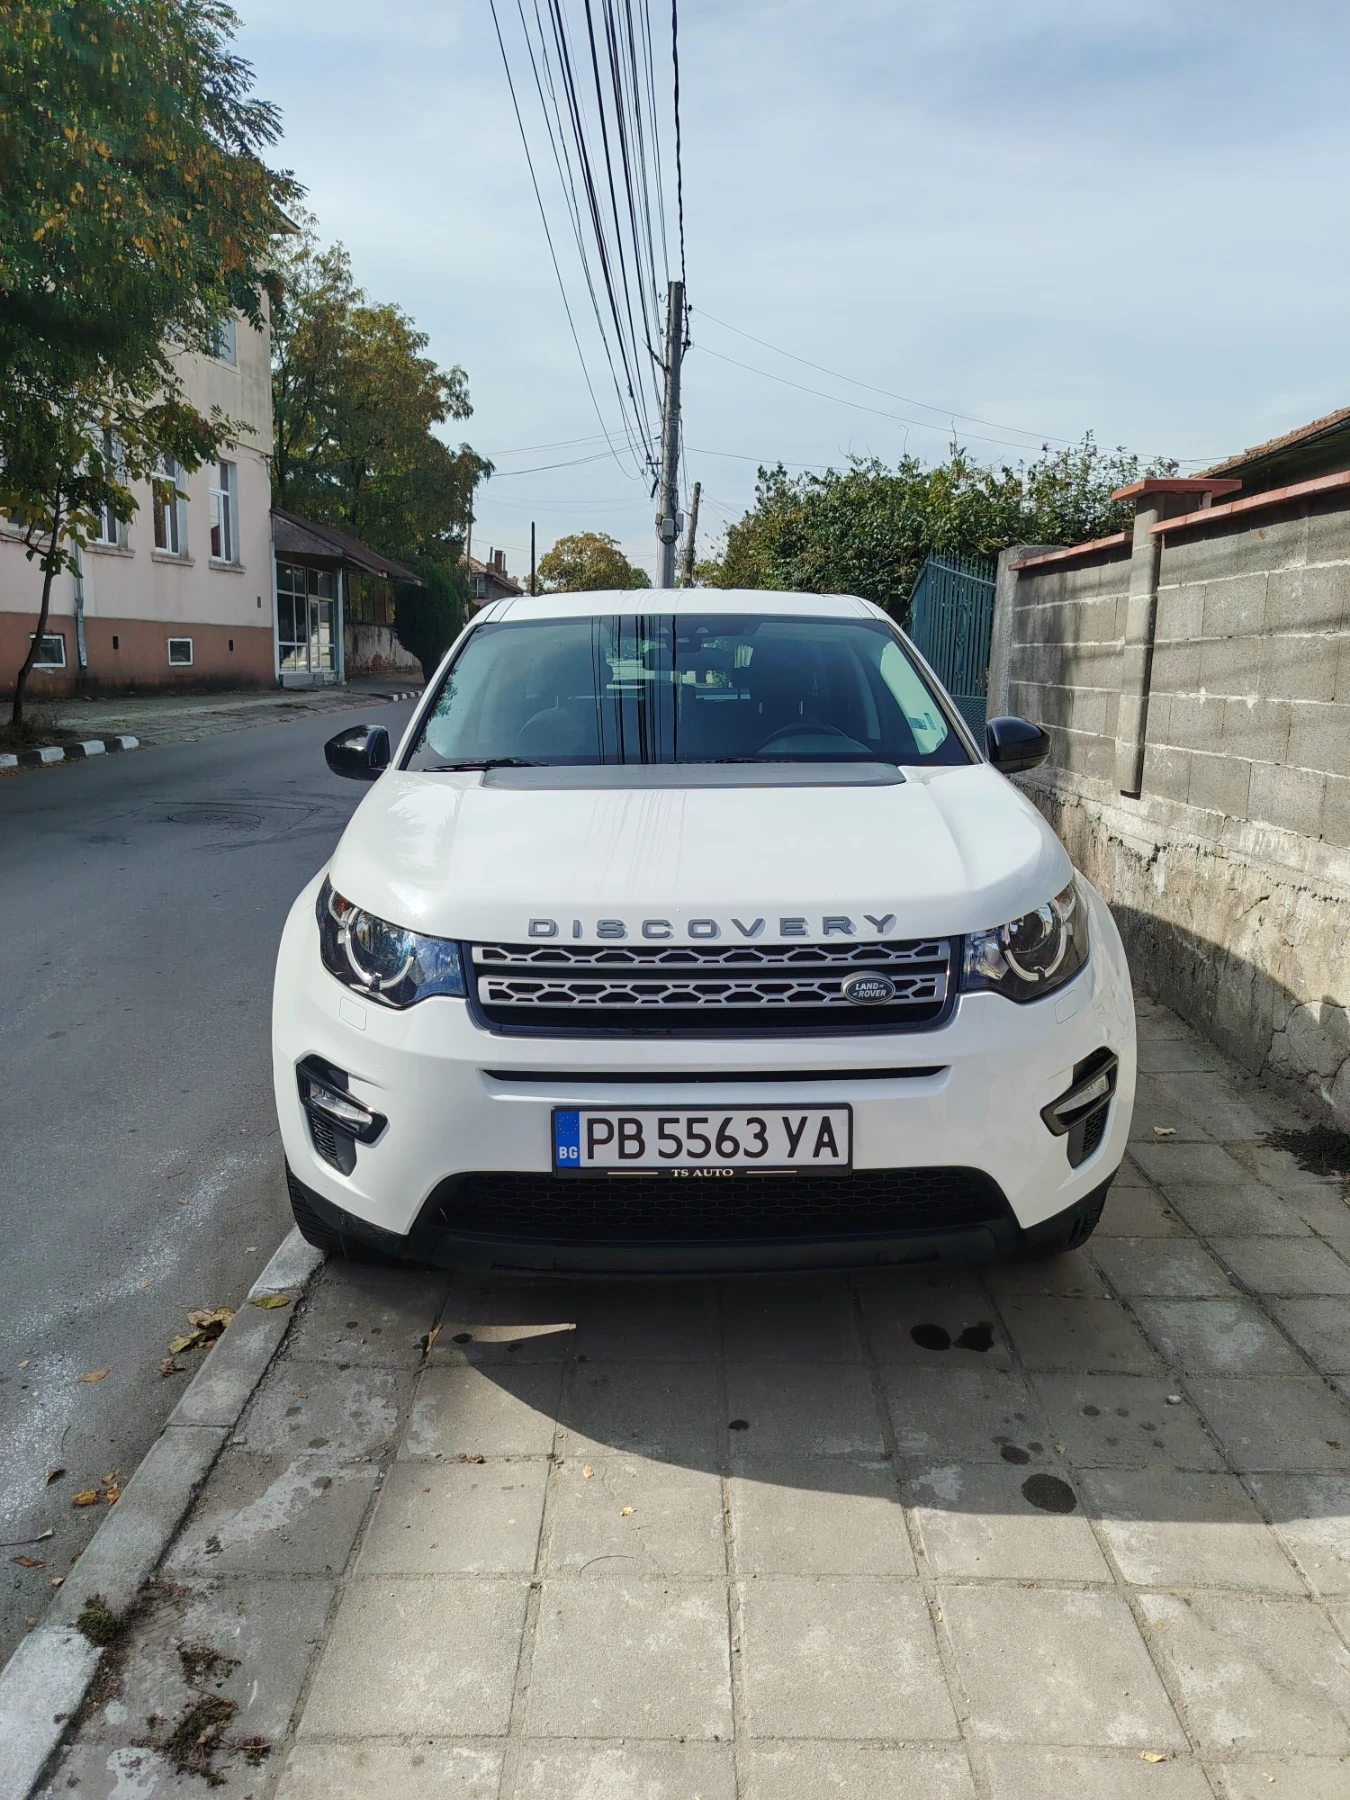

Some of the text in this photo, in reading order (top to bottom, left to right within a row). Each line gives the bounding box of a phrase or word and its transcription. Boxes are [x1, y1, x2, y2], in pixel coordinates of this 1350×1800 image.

[527, 914, 895, 937] DISCOVERY
[858, 990, 887, 998] ROVER
[587, 1116, 839, 1160] PB 5563 YA
[559, 1146, 578, 1159] BG
[671, 1169, 734, 1177] TS AUTO
